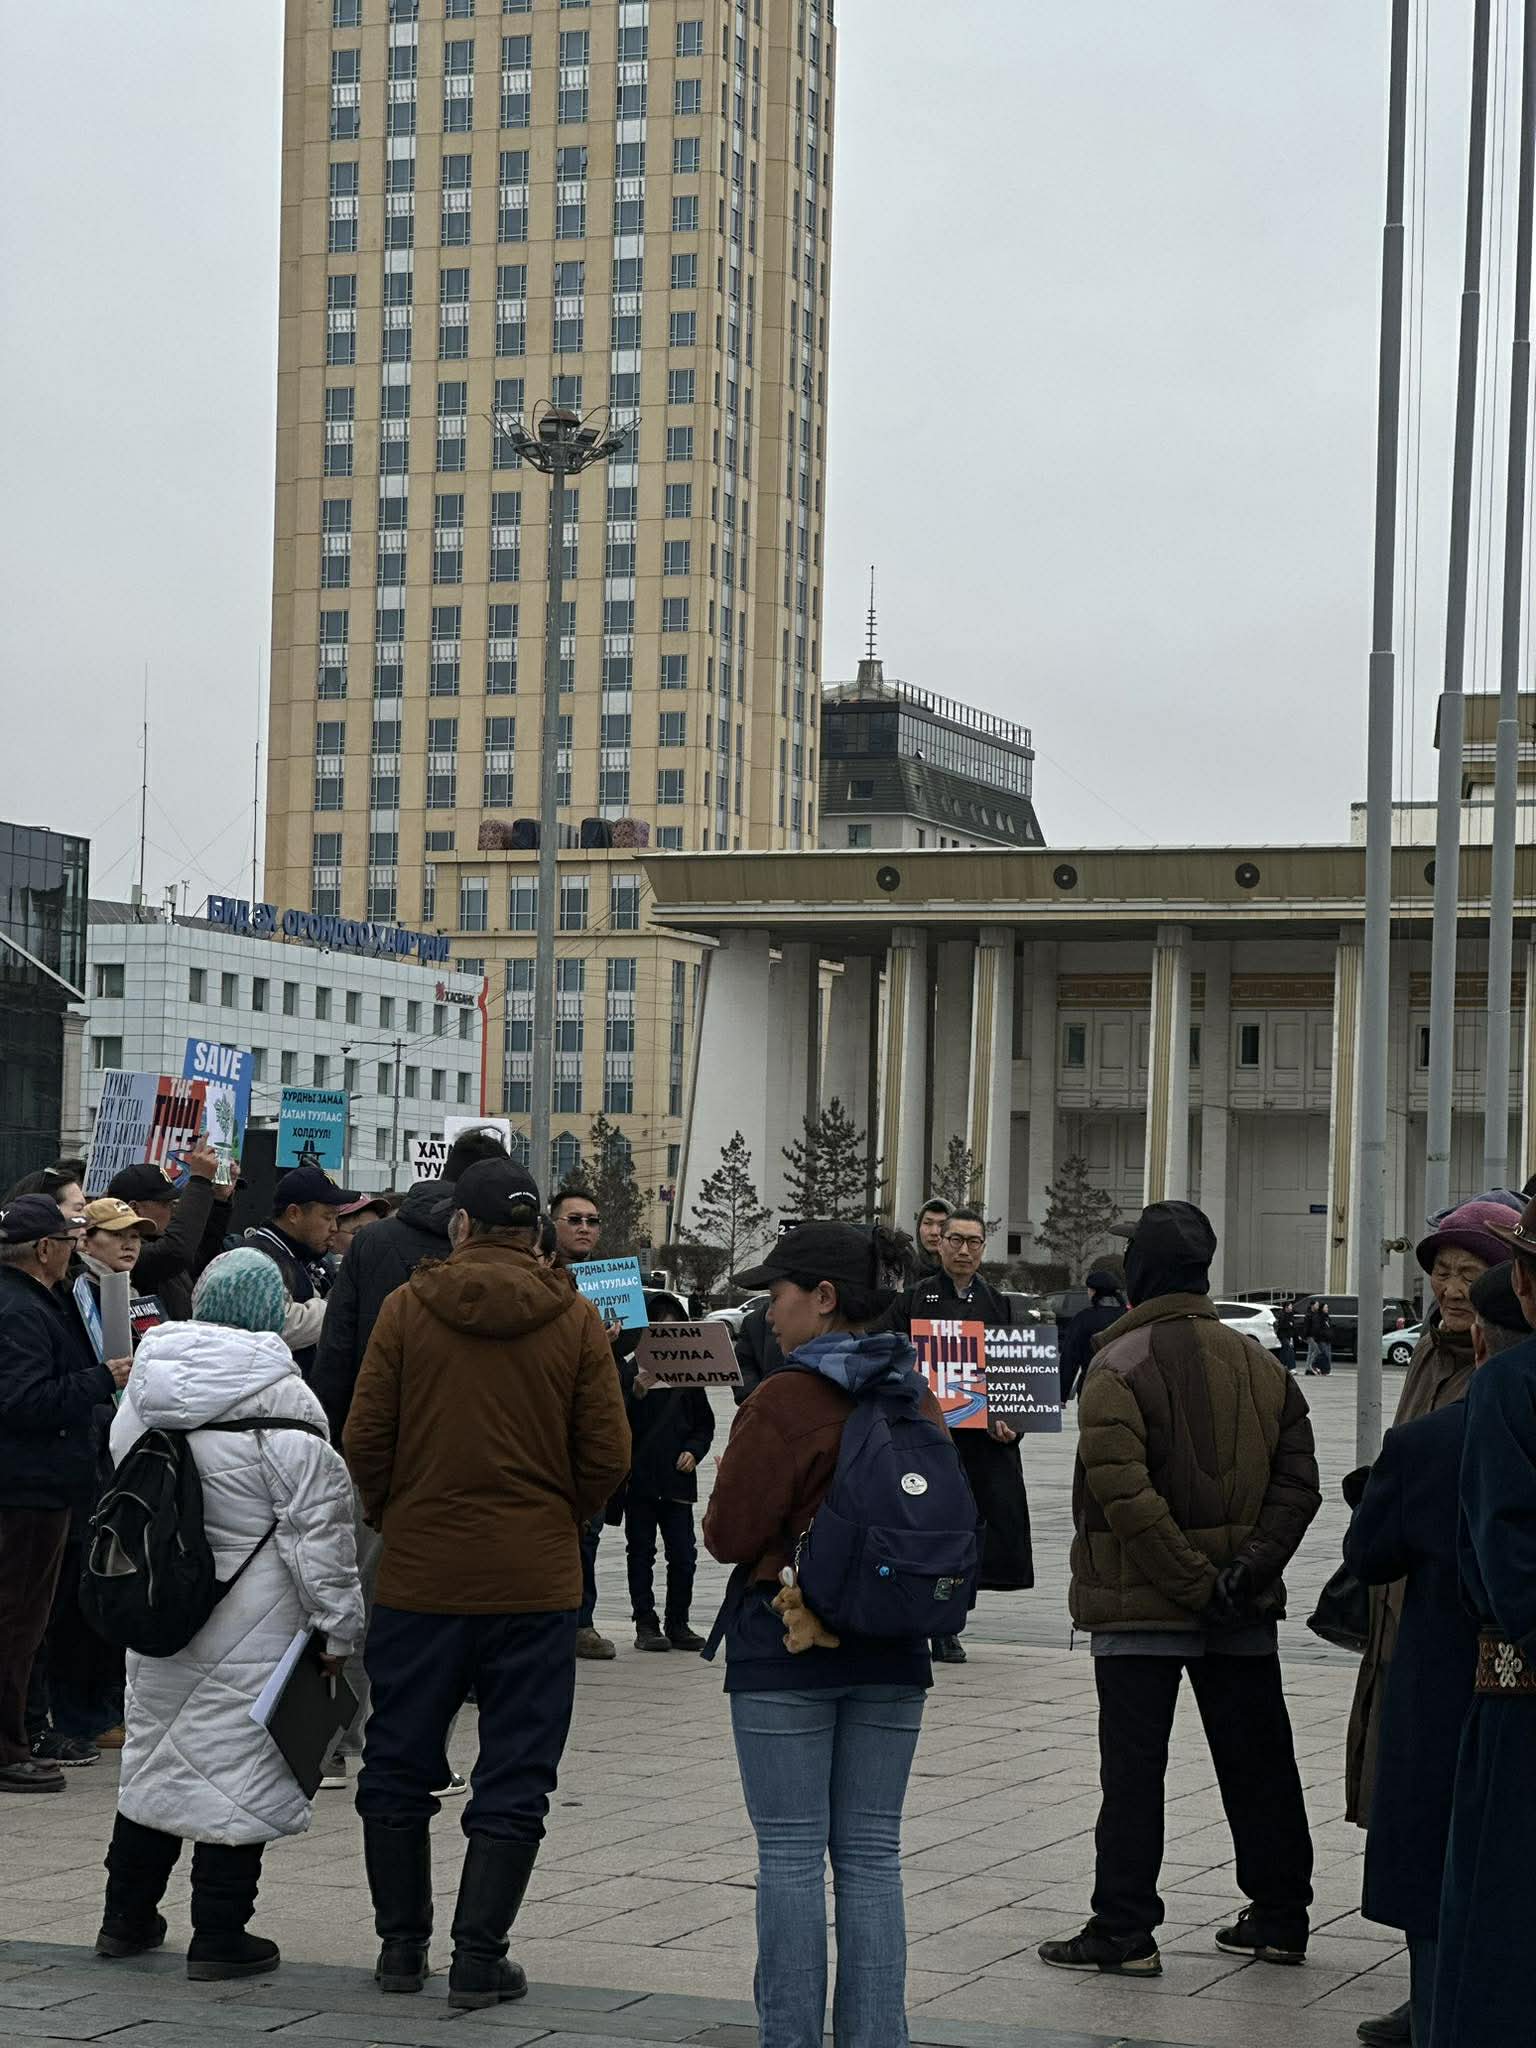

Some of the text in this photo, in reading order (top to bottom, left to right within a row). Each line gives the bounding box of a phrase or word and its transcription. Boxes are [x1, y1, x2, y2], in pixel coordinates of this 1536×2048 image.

[207, 895, 250, 936] БИД
[253, 903, 278, 932] ЭХ
[283, 909, 371, 947] ОРОНДОО
[194, 1042, 243, 1080] SAVE
[170, 1078, 193, 1107] THE
[282, 1091, 343, 1105] ХУРДНЫ ЗАМАА
[281, 1109, 342, 1122] ХАТАН ТУУЛААС
[292, 1127, 331, 1139] ХОЛДУУЛ!
[570, 1260, 636, 1277] УРДНЫ ЗАМАА
[600, 1276, 639, 1289] ТУУЛААС
[591, 1293, 631, 1307] ОЛДУУЛ!
[649, 1327, 703, 1338] ХАТАН
[930, 1320, 963, 1344] THE
[984, 1329, 1036, 1342] ХААН
[650, 1350, 715, 1360] ТУУЛАА
[984, 1345, 1057, 1359] ЧИНГИС
[984, 1364, 1059, 1374] АРАВНАЙЛСАН
[988, 1382, 1026, 1391] ХАТАН
[988, 1393, 1035, 1402] ТУУЛАА
[988, 1404, 1060, 1413] ХАМГААЛЪЯ
